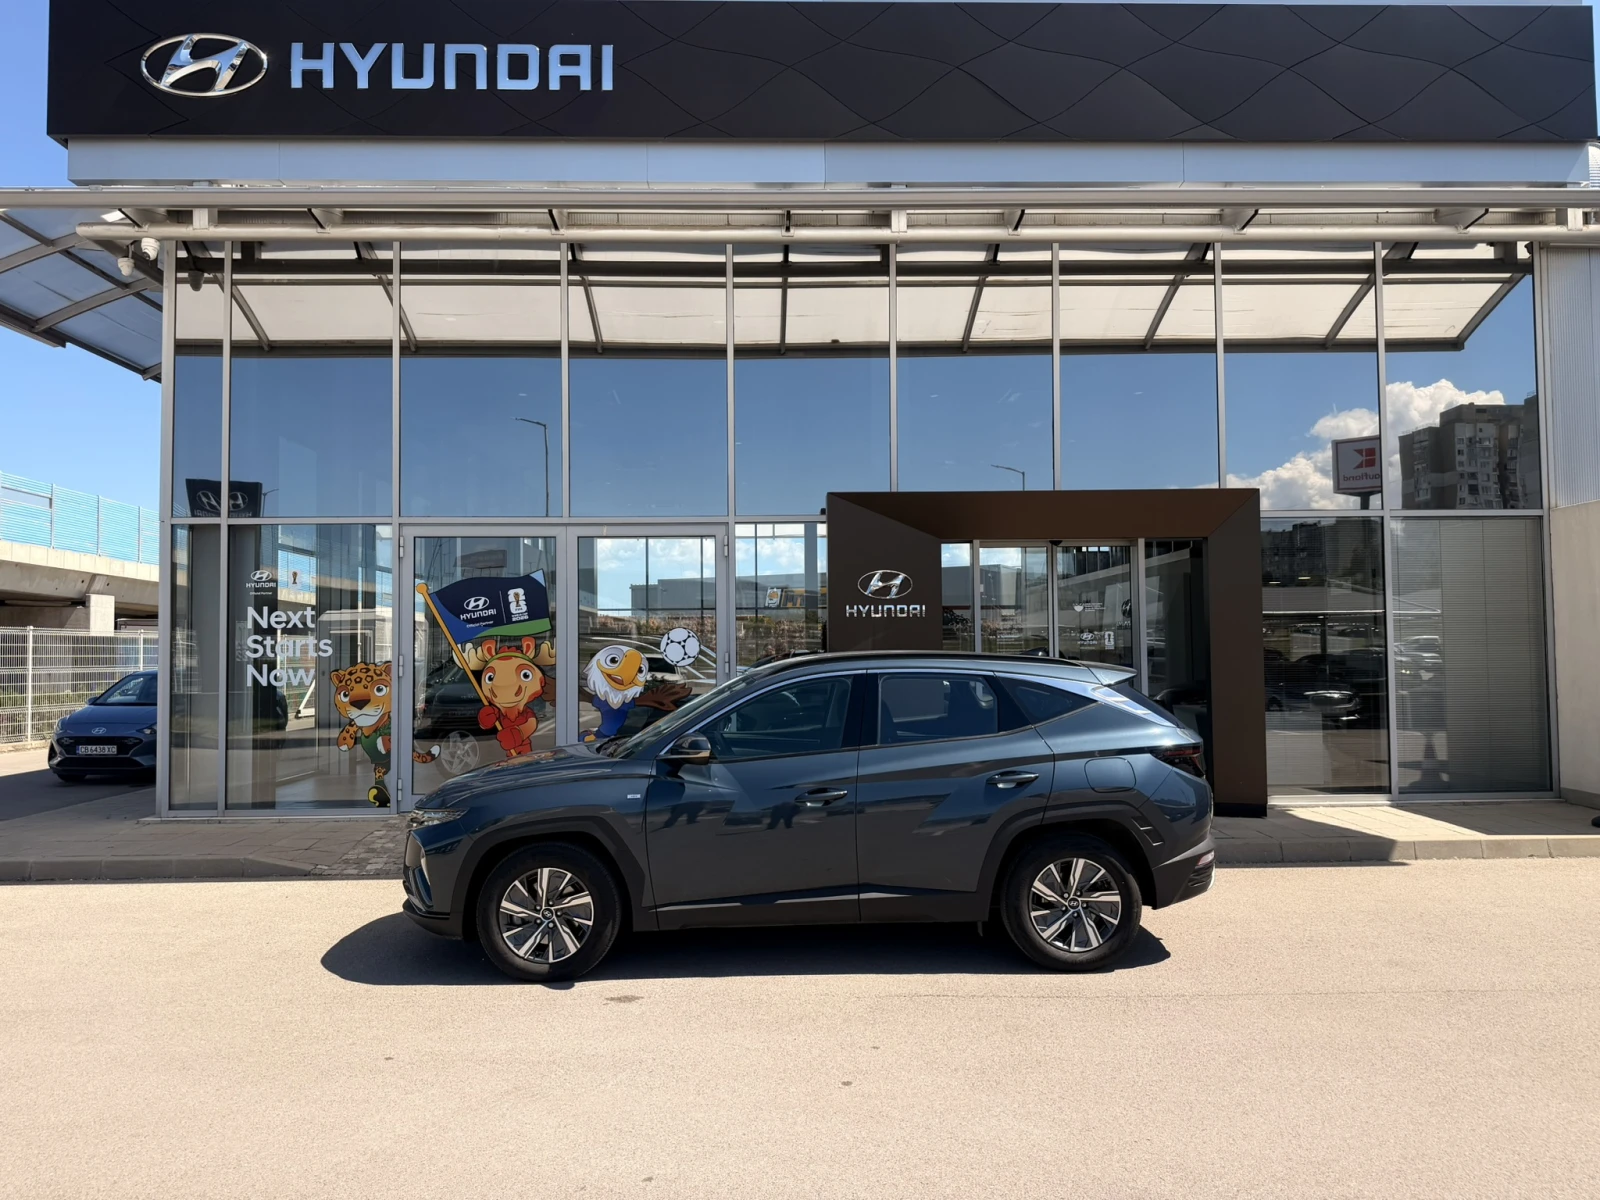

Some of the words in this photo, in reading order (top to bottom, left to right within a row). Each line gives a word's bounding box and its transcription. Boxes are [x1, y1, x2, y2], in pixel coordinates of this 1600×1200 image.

[290, 42, 614, 91] HYUNDAI
[247, 606, 316, 629] Next
[460, 608, 497, 620] HYUNDAI
[845, 604, 926, 618] HYUNDAI
[246, 634, 333, 658] Starts
[247, 664, 315, 687] Now
